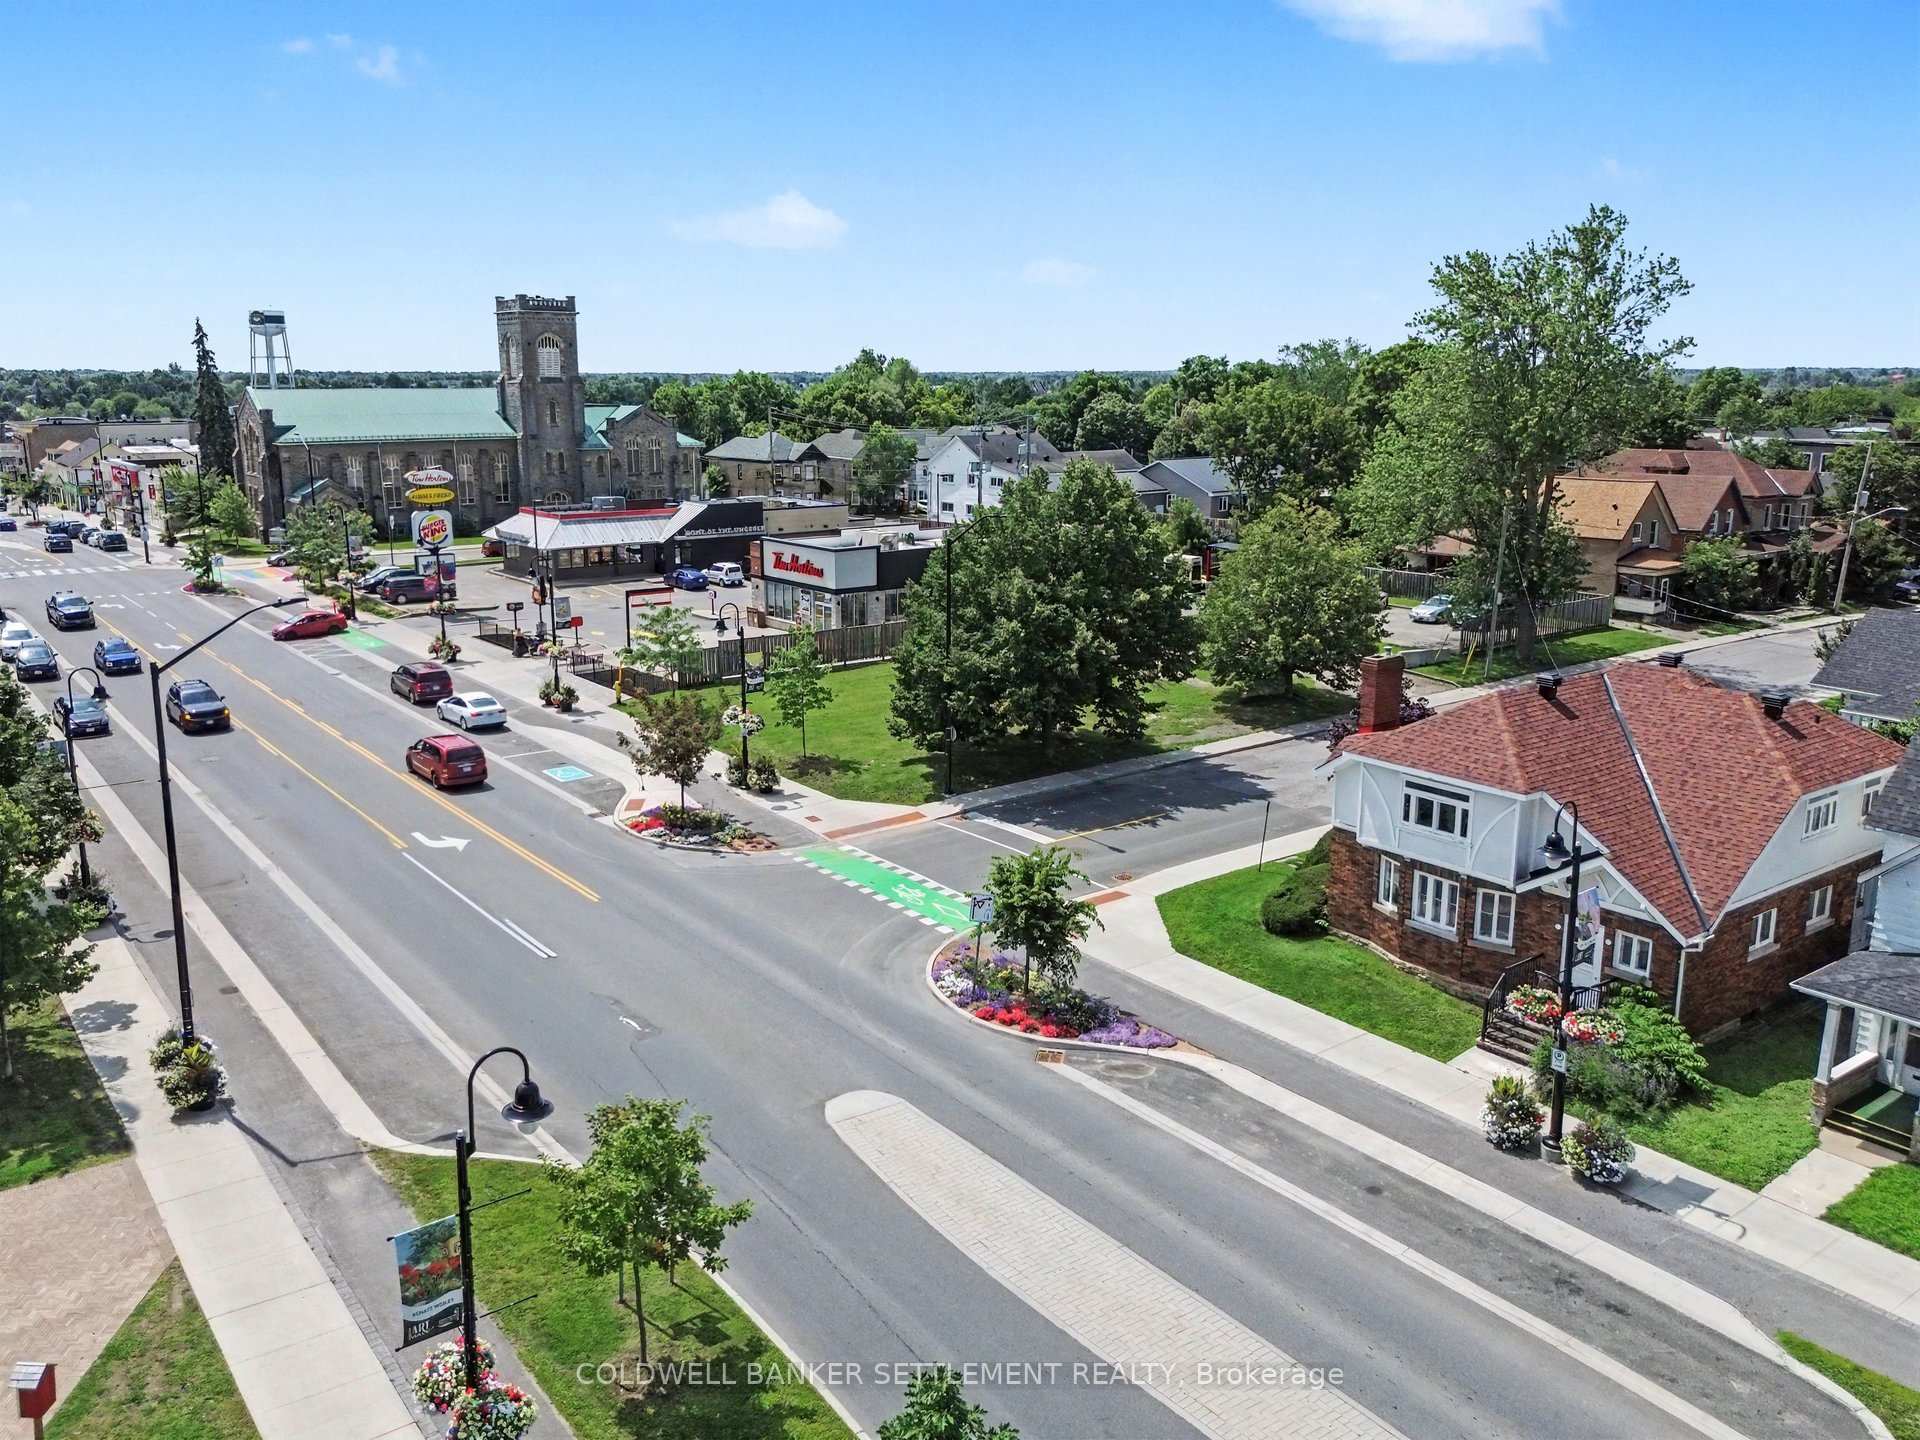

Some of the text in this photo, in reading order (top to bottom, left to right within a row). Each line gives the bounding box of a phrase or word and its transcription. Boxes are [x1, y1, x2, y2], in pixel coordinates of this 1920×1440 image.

[422, 525, 447, 538] KING
[772, 552, 824, 578] Tim Hortons
